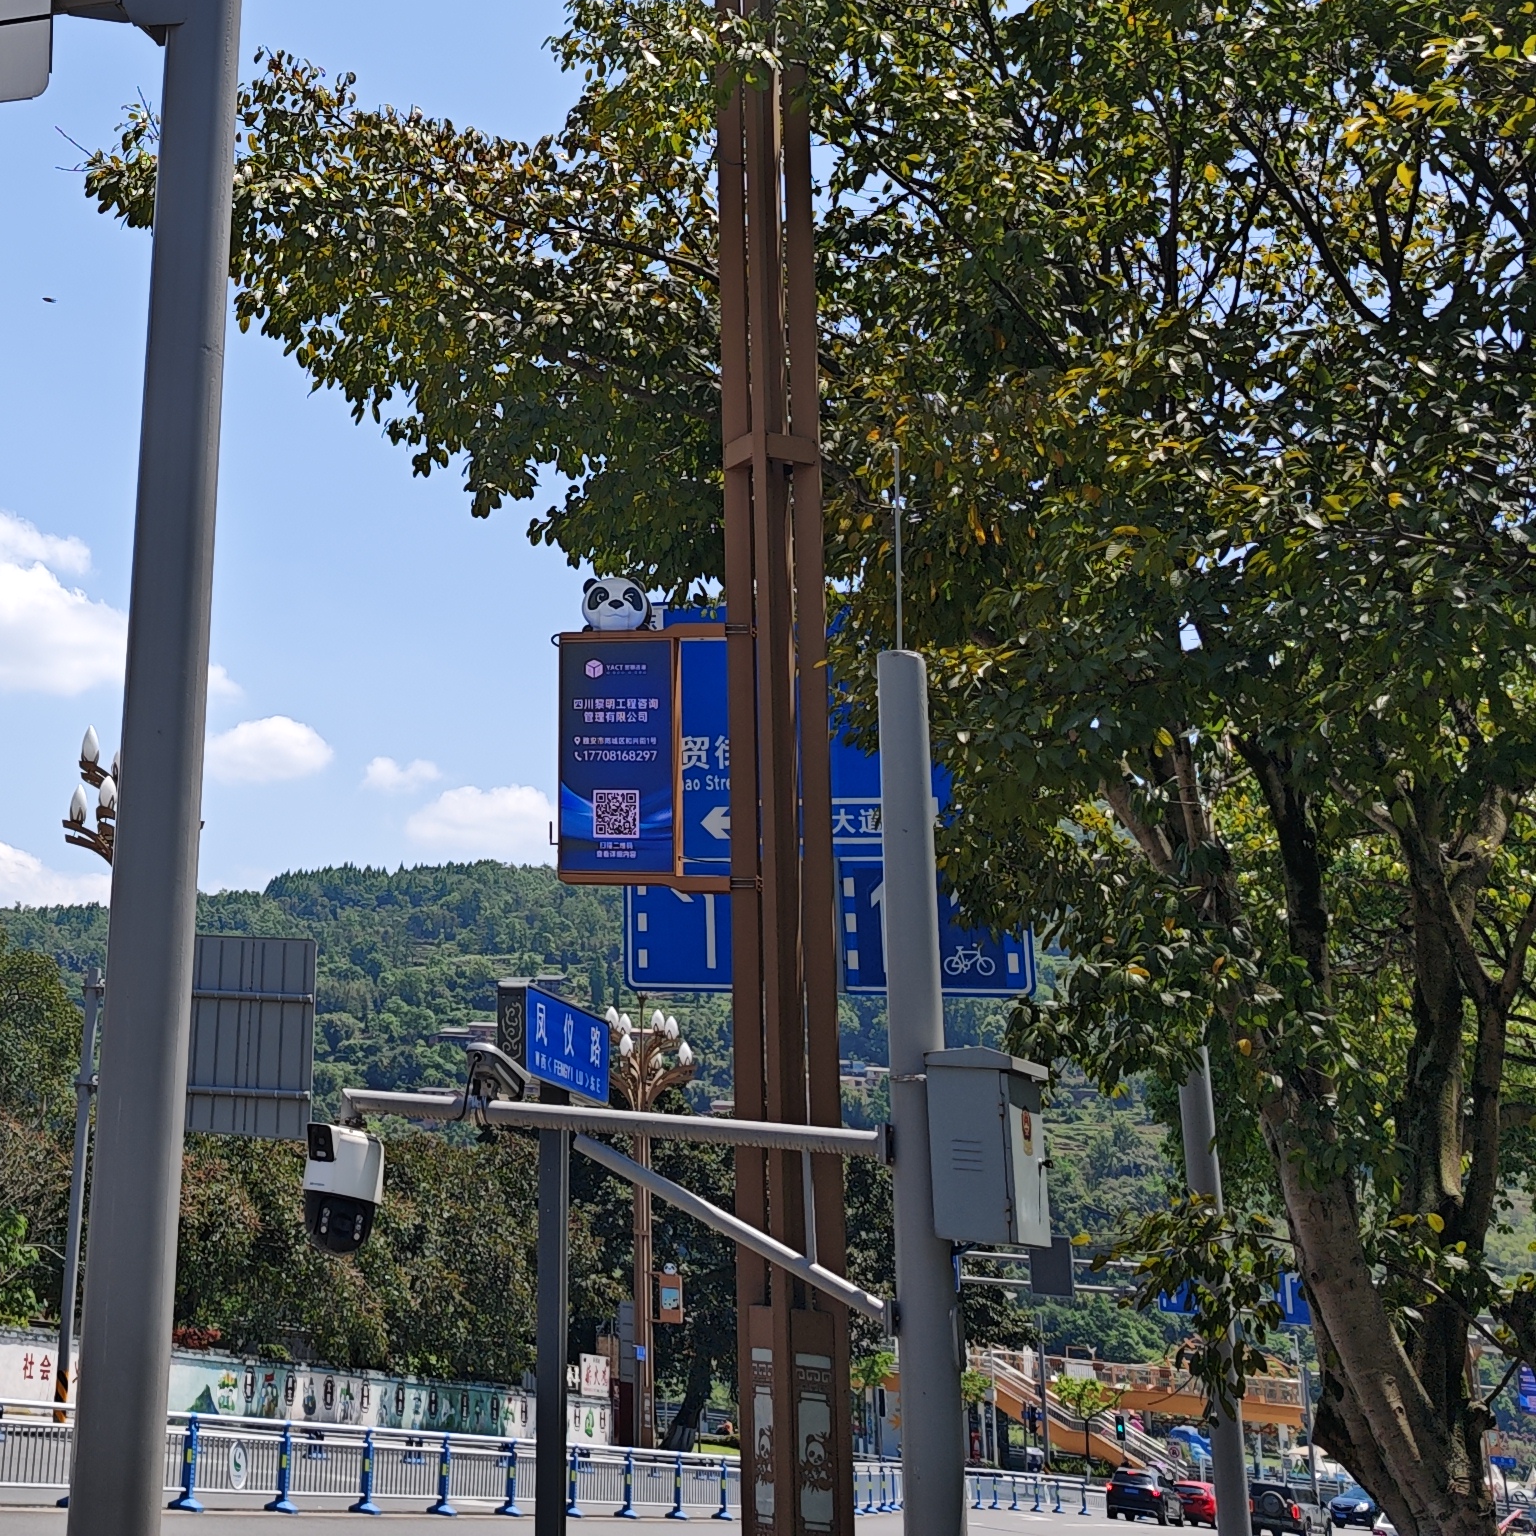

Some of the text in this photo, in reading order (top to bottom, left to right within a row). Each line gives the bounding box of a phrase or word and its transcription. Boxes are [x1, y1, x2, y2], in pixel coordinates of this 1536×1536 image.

[573, 698, 659, 710] 四川黎明工程咨询
[584, 711, 648, 723] 管理有限公司
[583, 750, 658, 762] 17708168297
[535, 1002, 602, 1069] 凤仪路
